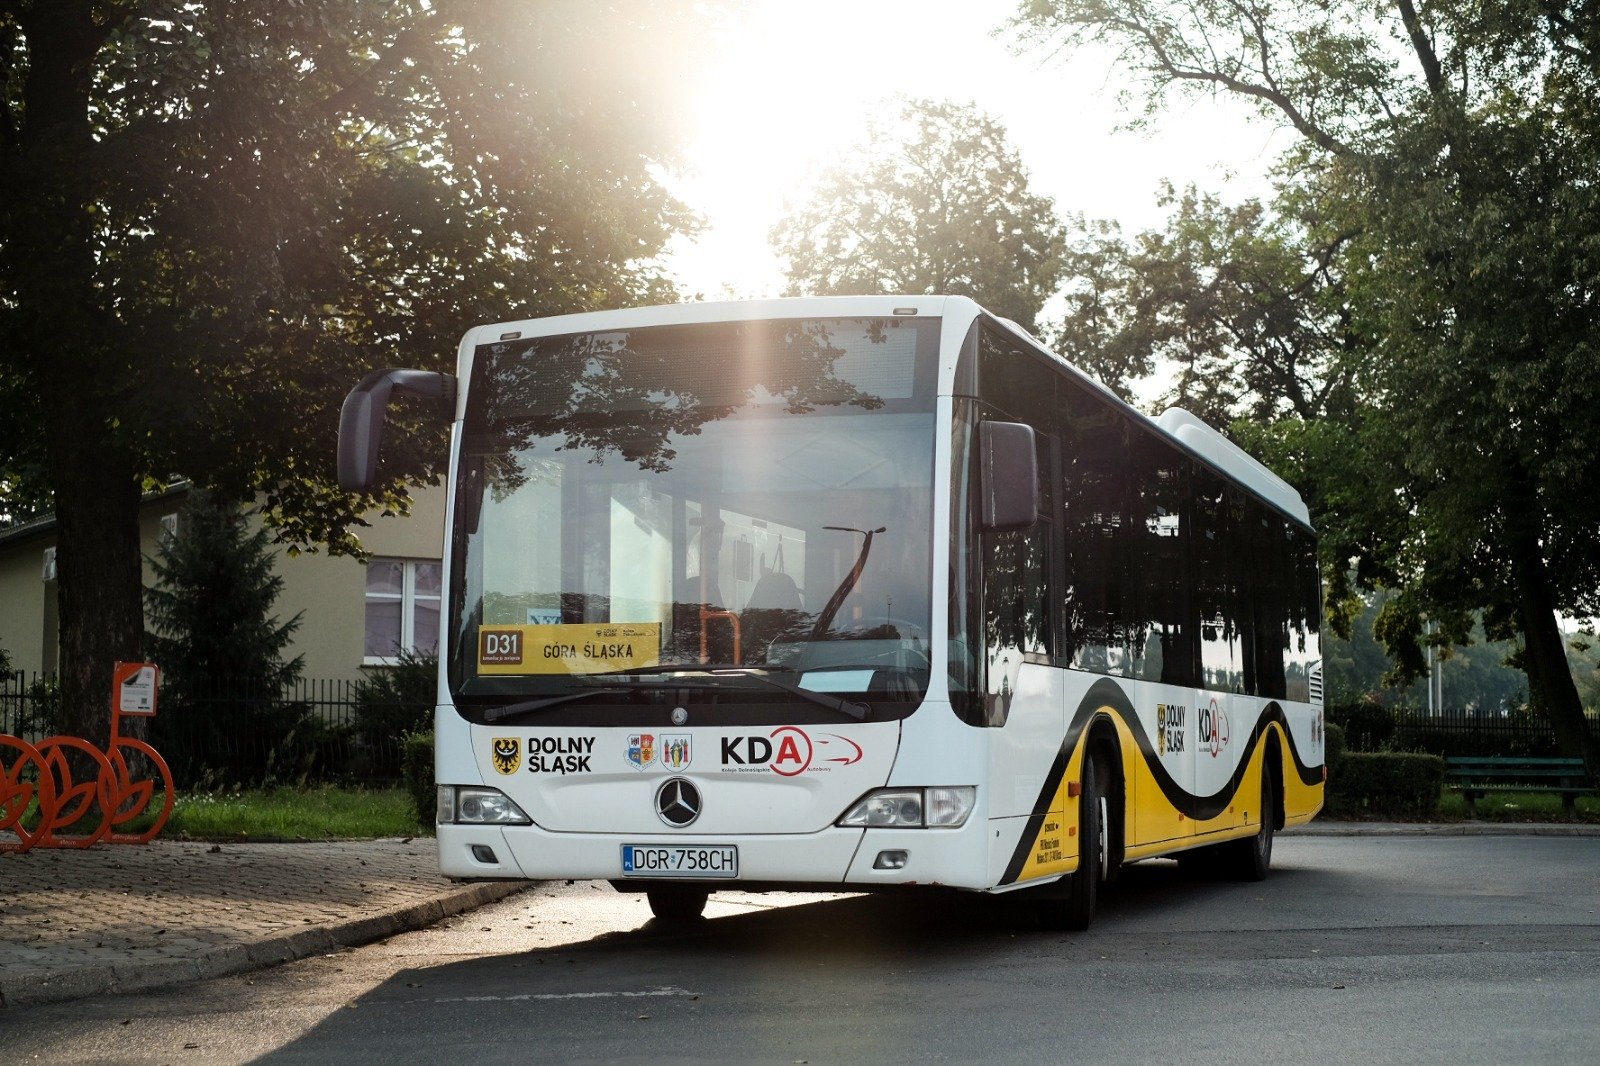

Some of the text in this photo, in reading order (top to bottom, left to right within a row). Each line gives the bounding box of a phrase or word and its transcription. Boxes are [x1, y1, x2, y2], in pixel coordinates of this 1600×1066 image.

[486, 634, 517, 654] D31
[543, 641, 633, 660] GÓRA ŚLĄSKA
[1167, 704, 1186, 727] DOLNY
[1198, 708, 1218, 743] KDA
[528, 737, 595, 754] DOLNY
[721, 736, 802, 764] KDA
[1167, 726, 1185, 755] ŚLĄSK
[528, 752, 591, 775] ŚLĄSK
[633, 849, 733, 871] DGR 758CH
